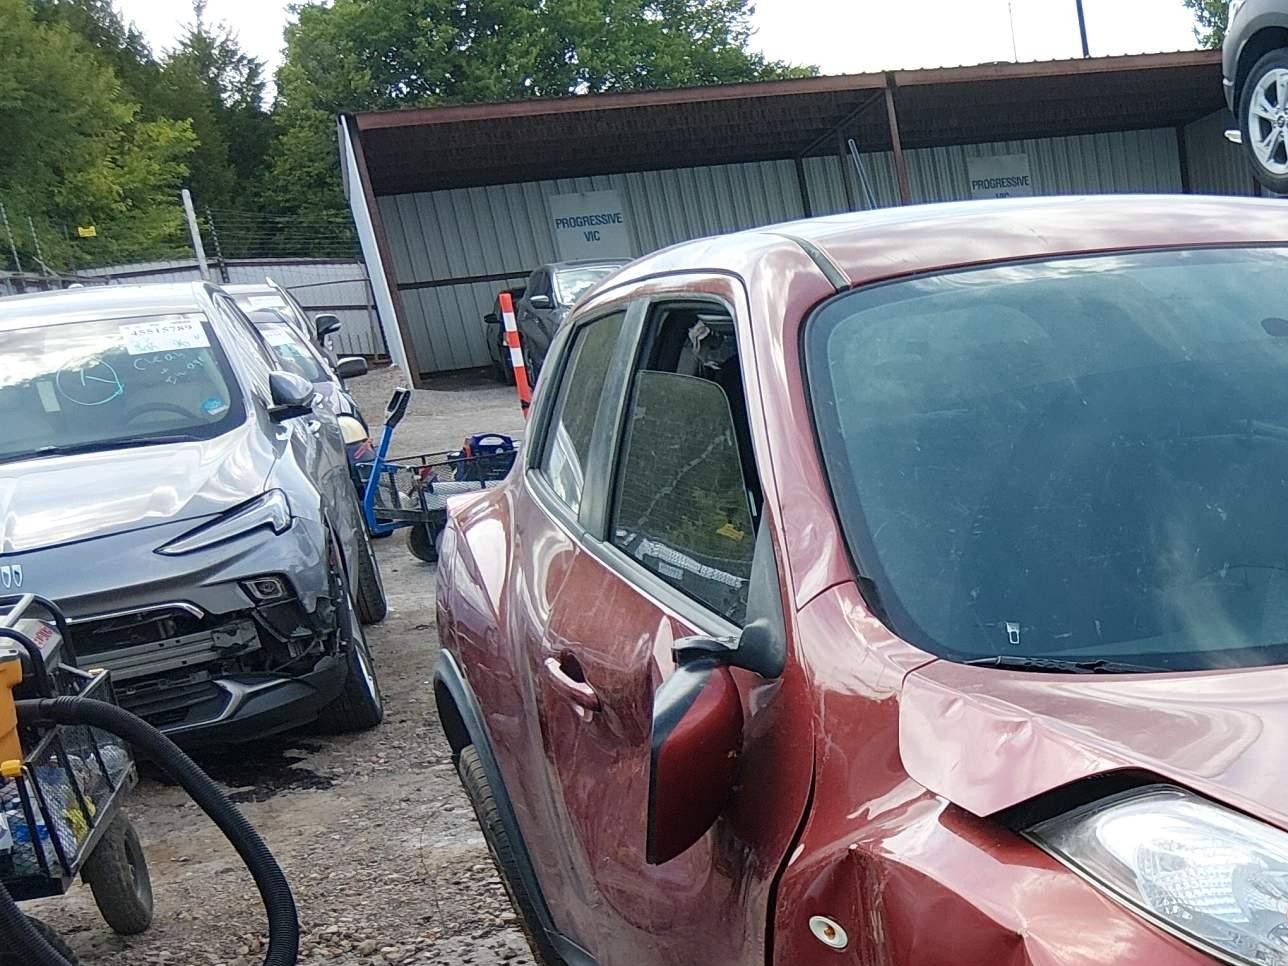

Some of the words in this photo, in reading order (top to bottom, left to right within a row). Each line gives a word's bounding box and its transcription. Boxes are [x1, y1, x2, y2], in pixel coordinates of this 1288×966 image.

[971, 175, 1030, 191] PROGRESSIVE
[555, 212, 623, 229] PROGRESSIVE
[583, 230, 601, 242] VIC
